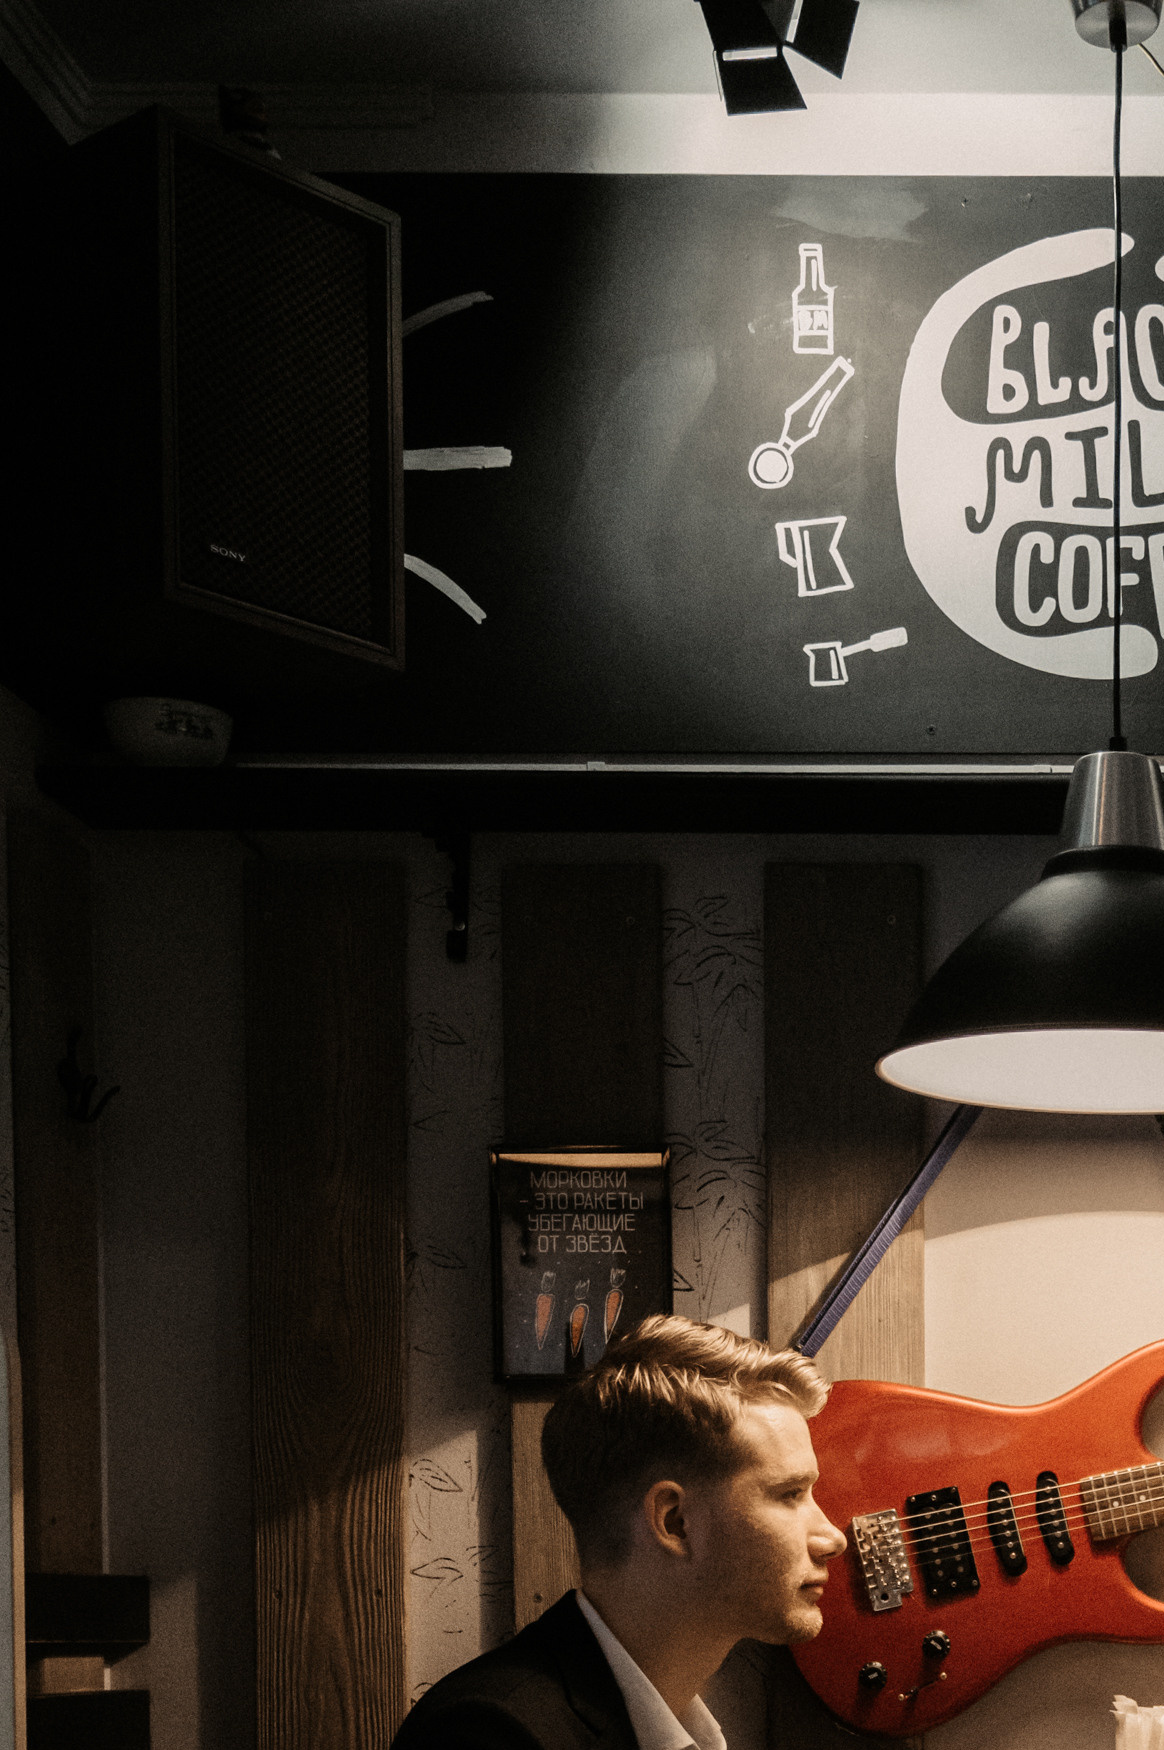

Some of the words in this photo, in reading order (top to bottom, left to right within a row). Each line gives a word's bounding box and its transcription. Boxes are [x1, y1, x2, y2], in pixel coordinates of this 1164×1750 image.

[210, 544, 246, 562] SONY
[530, 1171, 627, 1189] МОРКОВКИ
[535, 1192, 569, 1210] ЭТО
[573, 1192, 644, 1210] РАКЕТЫ
[528, 1213, 636, 1233] УБЕГАЮЩИЕ
[538, 1235, 560, 1253] ОТ
[565, 1233, 627, 1254] ЗВЁЗД
